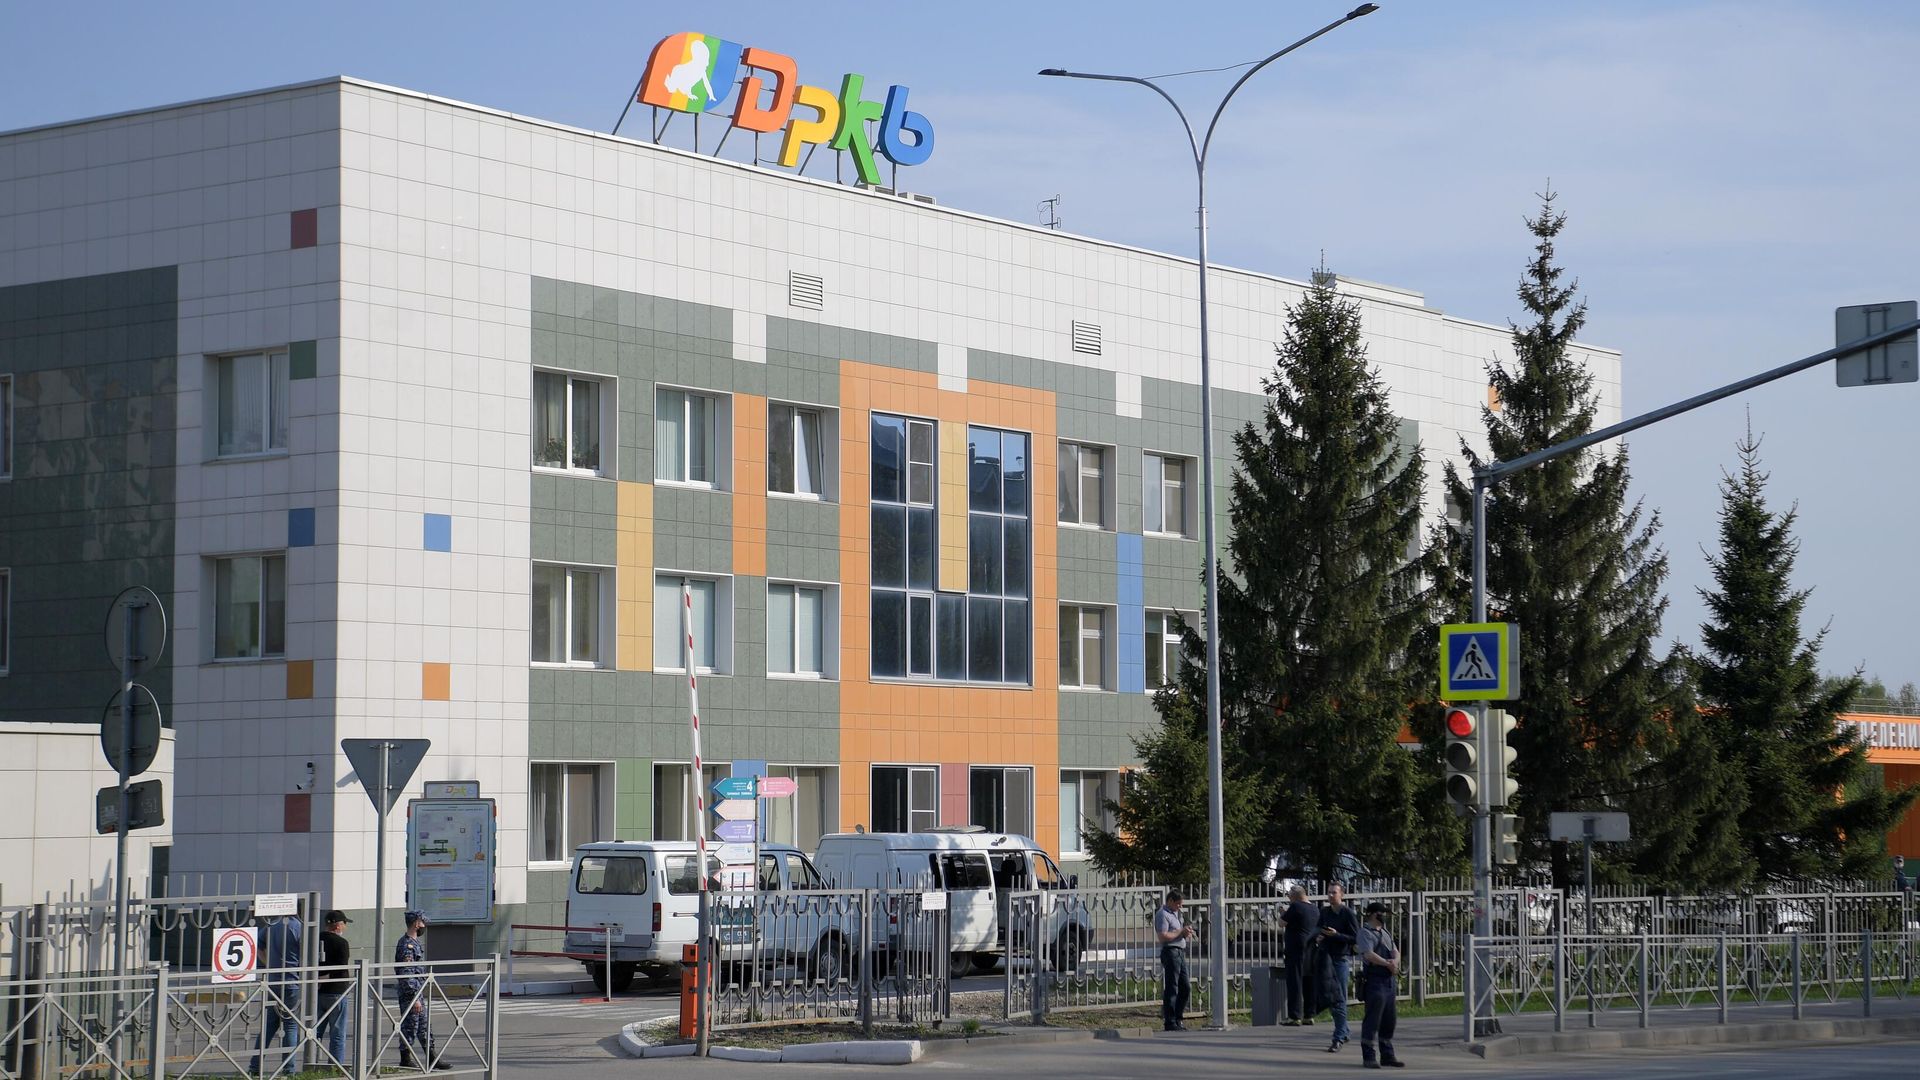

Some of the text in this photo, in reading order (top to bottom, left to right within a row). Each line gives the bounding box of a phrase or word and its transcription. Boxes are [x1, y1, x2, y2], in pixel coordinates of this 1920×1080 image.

[746, 780, 753, 792] 4
[762, 780, 768, 792] 1
[746, 824, 753, 835] 7
[226, 940, 244, 967] 5
